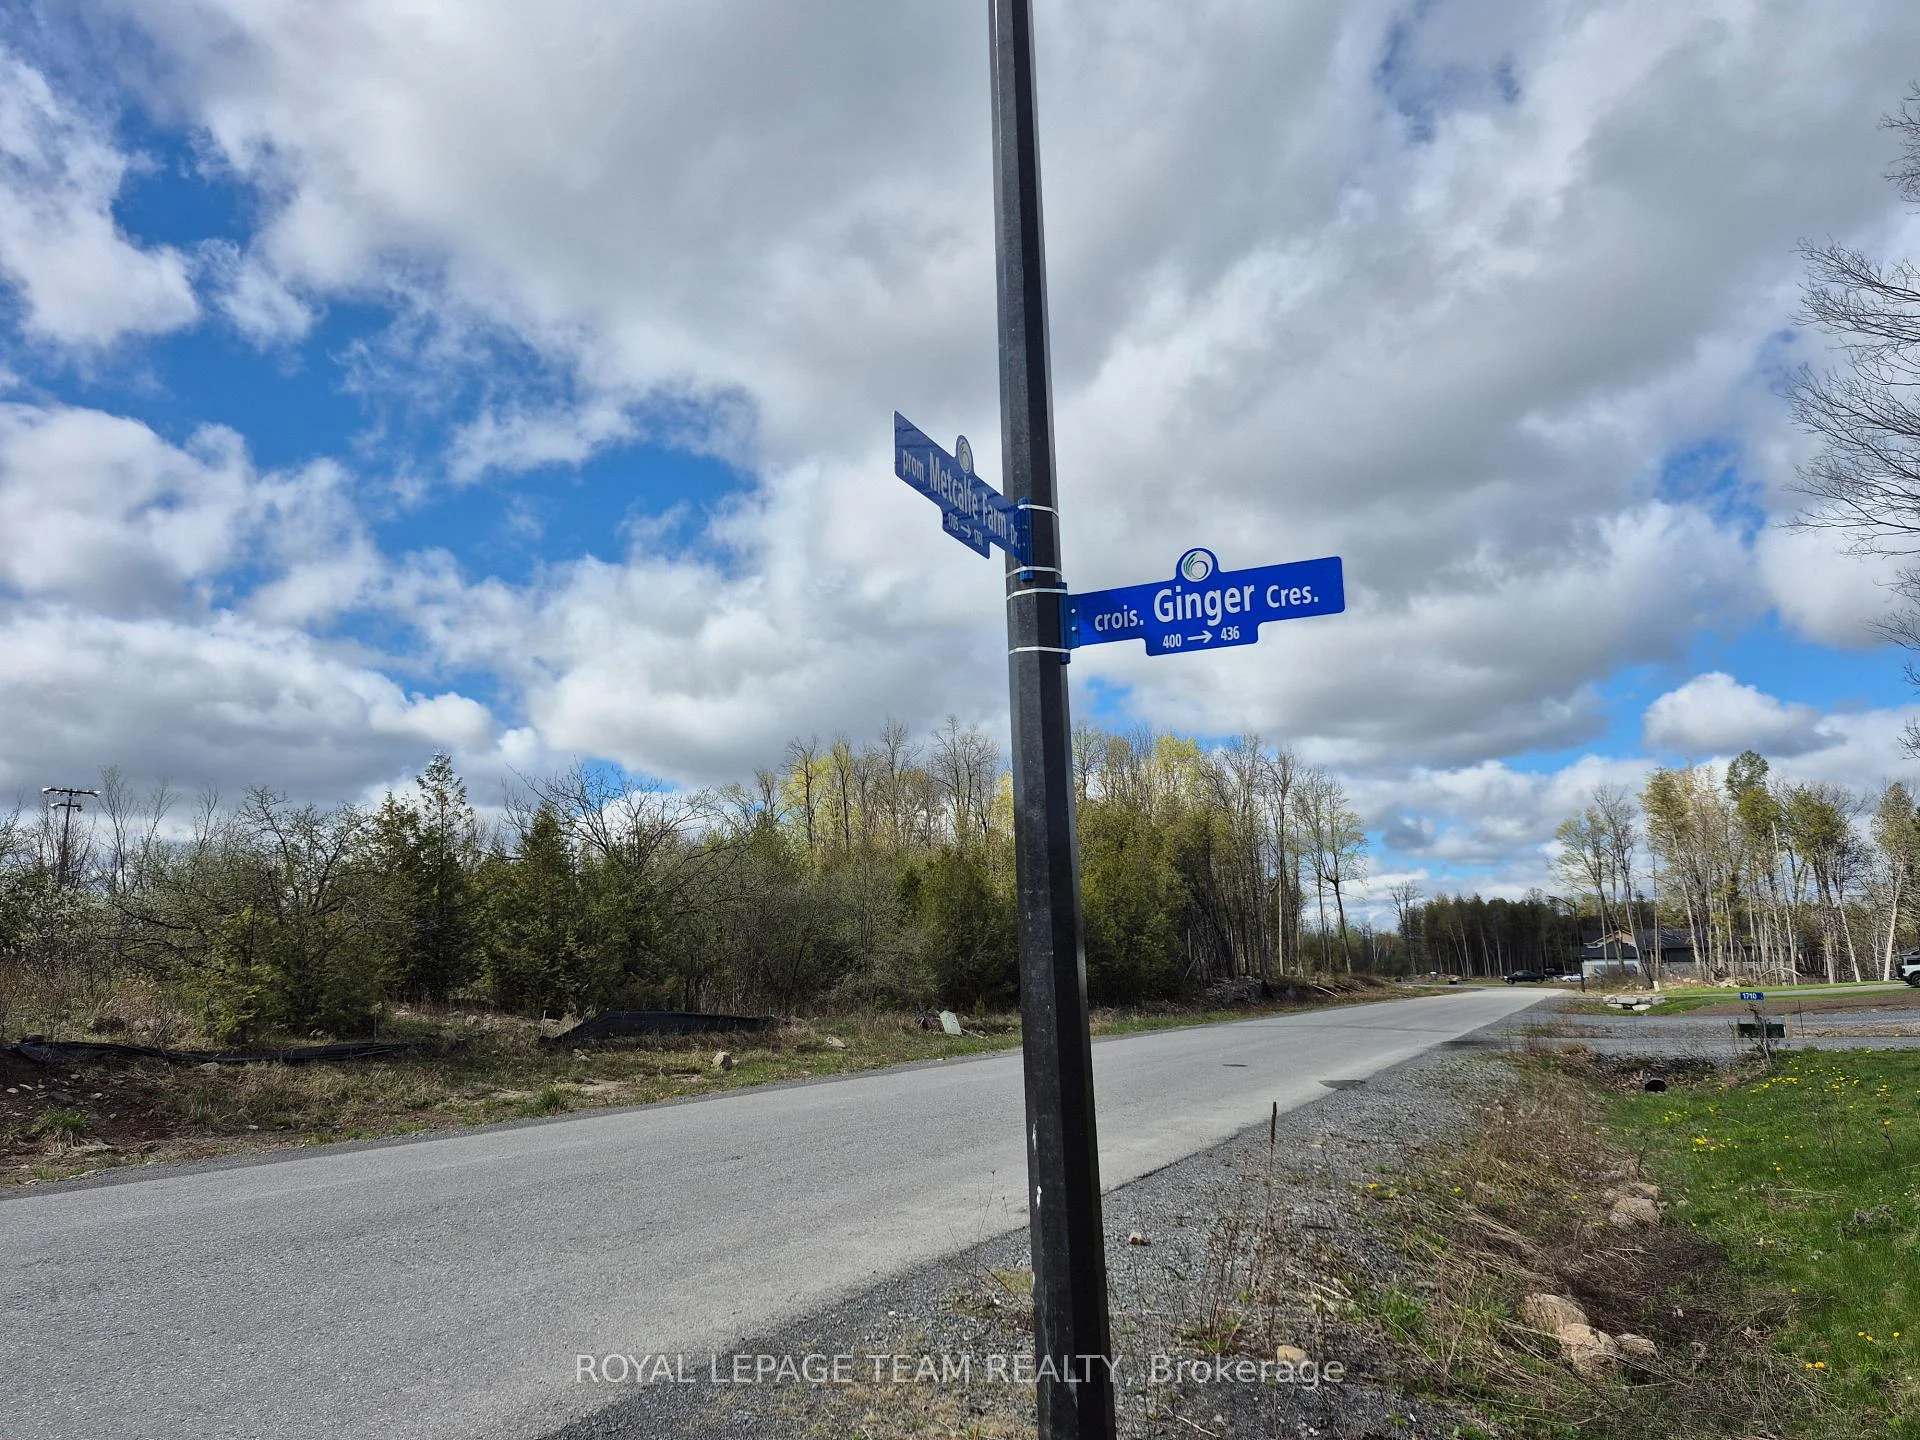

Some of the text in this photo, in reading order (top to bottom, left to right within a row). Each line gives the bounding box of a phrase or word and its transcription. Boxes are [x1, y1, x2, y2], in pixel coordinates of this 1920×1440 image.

[930, 451, 978, 521] Metcalfe
[982, 492, 1007, 540] Farm
[1094, 584, 1319, 632] crois. Ginger Cres.
[1162, 626, 1240, 649] 400 436
